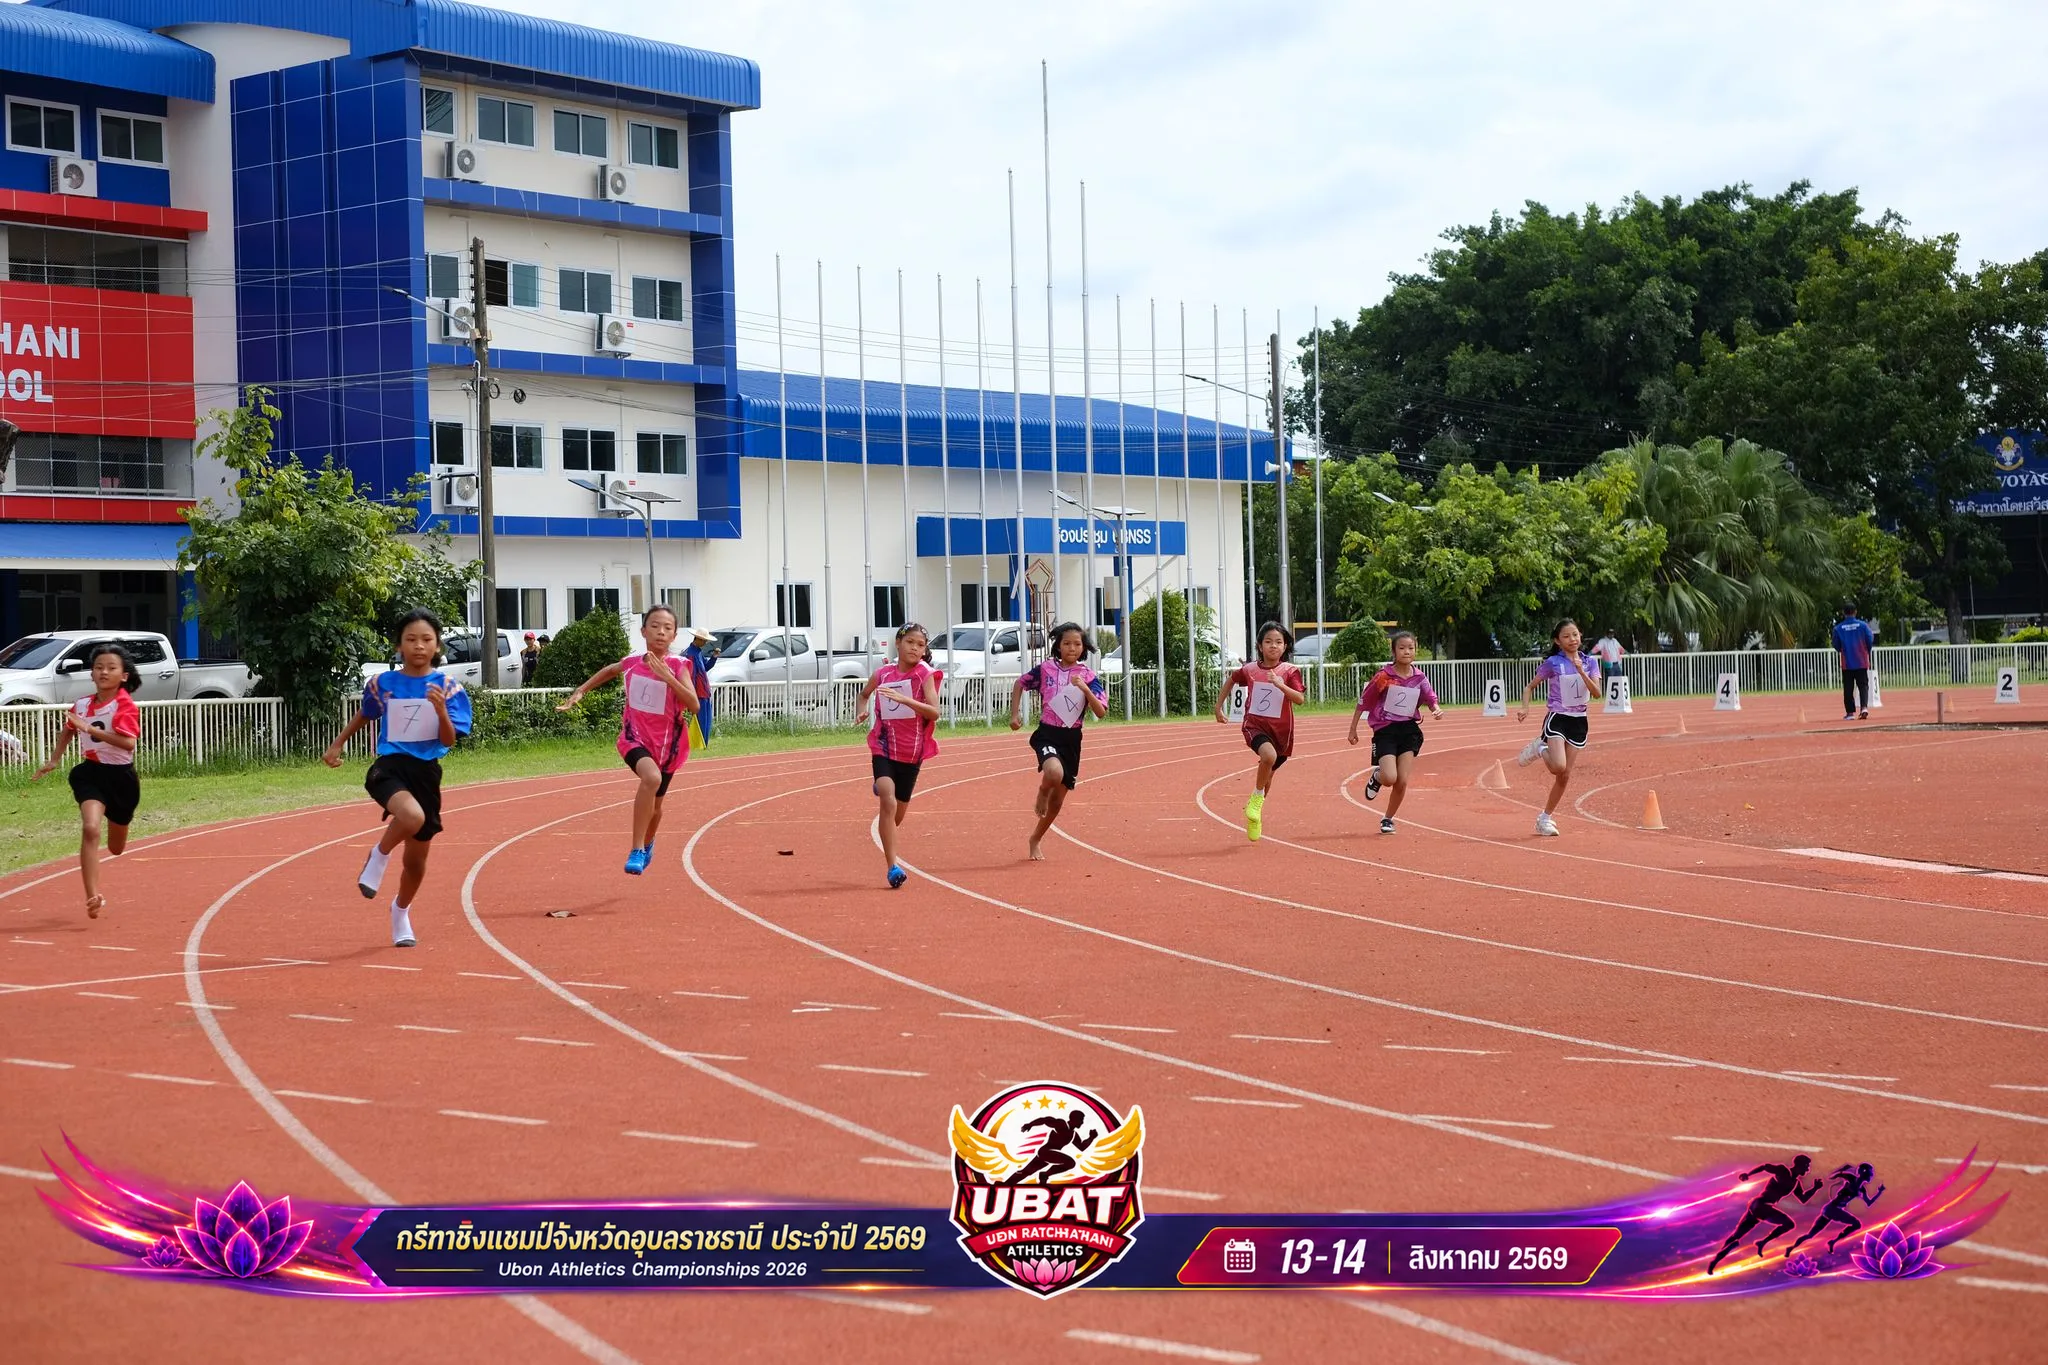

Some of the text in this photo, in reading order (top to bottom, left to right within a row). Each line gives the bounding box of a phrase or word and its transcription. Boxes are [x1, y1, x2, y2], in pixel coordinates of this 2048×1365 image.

[0, 368, 53, 403] OL
[1570, 679, 1583, 699] 1
[1610, 682, 1620, 700] 5
[1721, 680, 1731, 697] 4
[2001, 674, 2013, 690] 2
[1234, 689, 1243, 708] 8
[1257, 688, 1273, 712] 3
[1394, 692, 1407, 708] 2
[1489, 684, 1501, 703] 6
[1063, 694, 1079, 713] 4
[402, 704, 422, 734] 7
